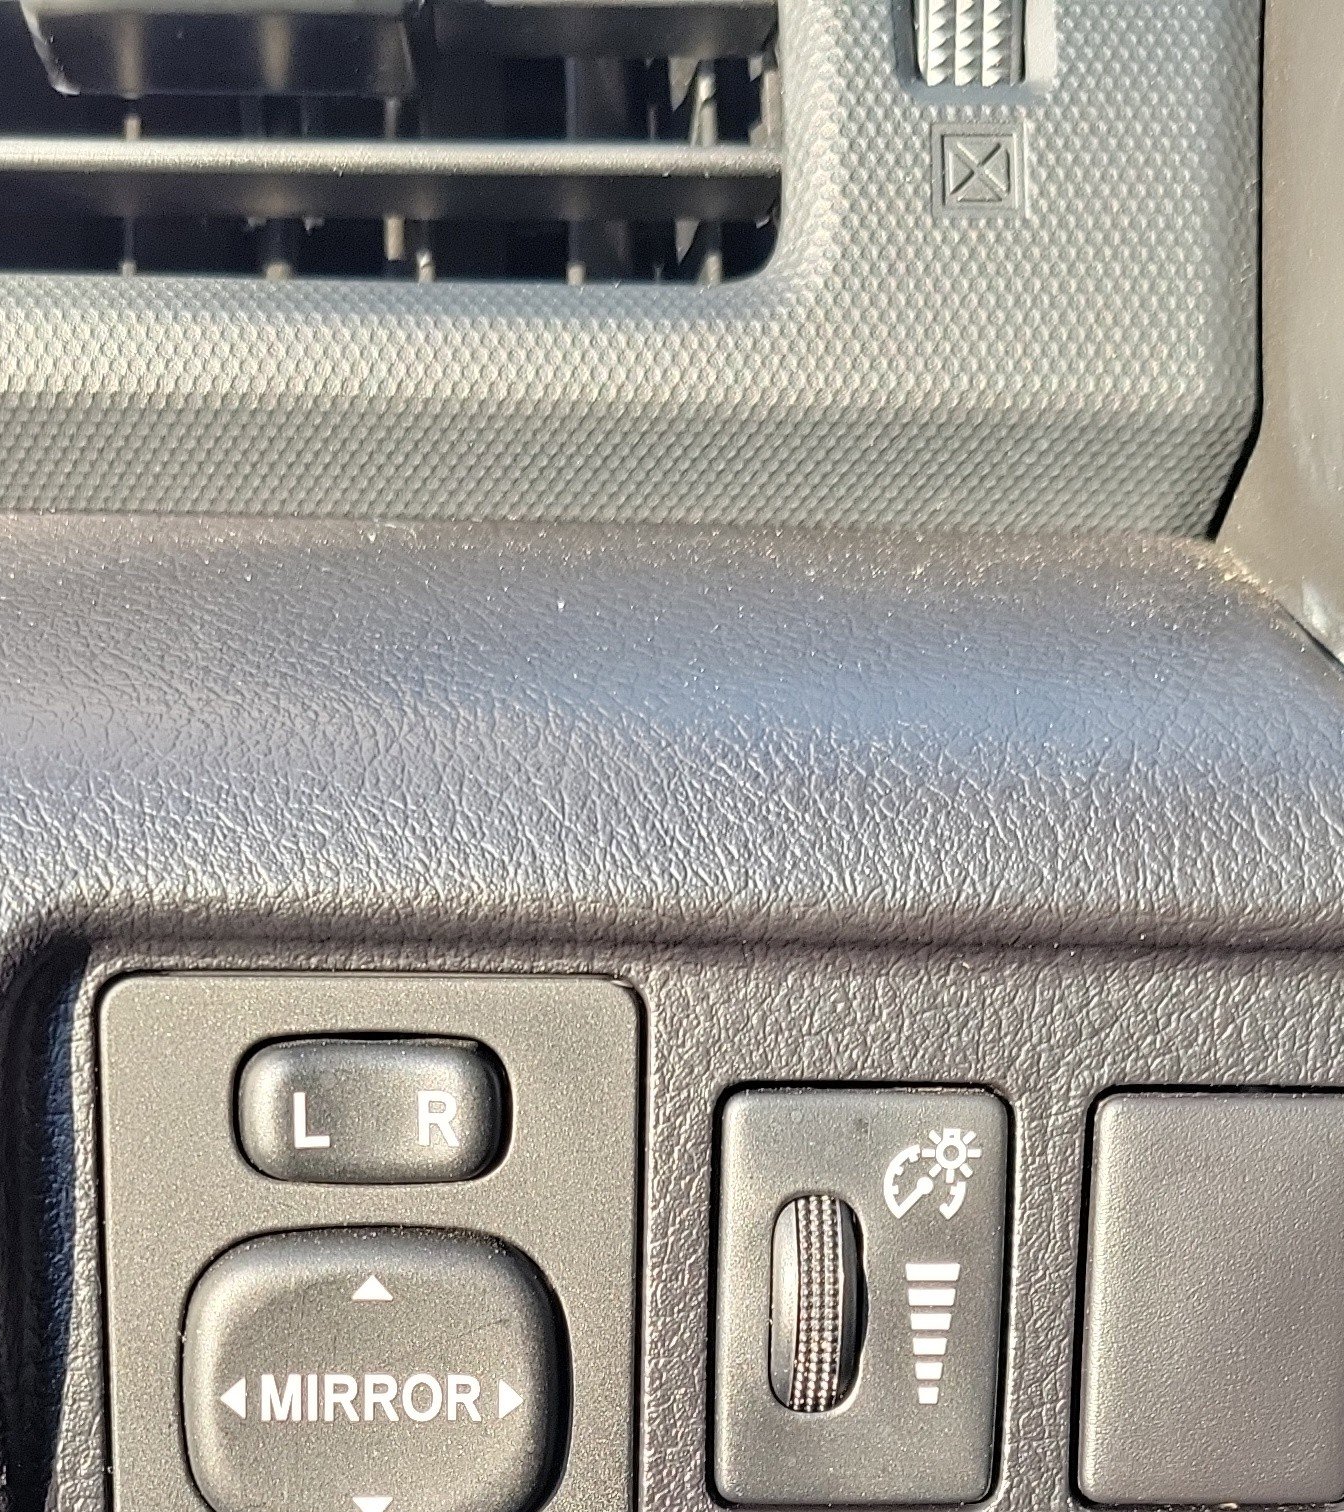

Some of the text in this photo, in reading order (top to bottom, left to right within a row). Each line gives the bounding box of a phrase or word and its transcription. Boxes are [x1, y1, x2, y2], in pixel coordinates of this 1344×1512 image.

[292, 1090, 459, 1148] L R
[259, 1374, 482, 1423] MIRROR
